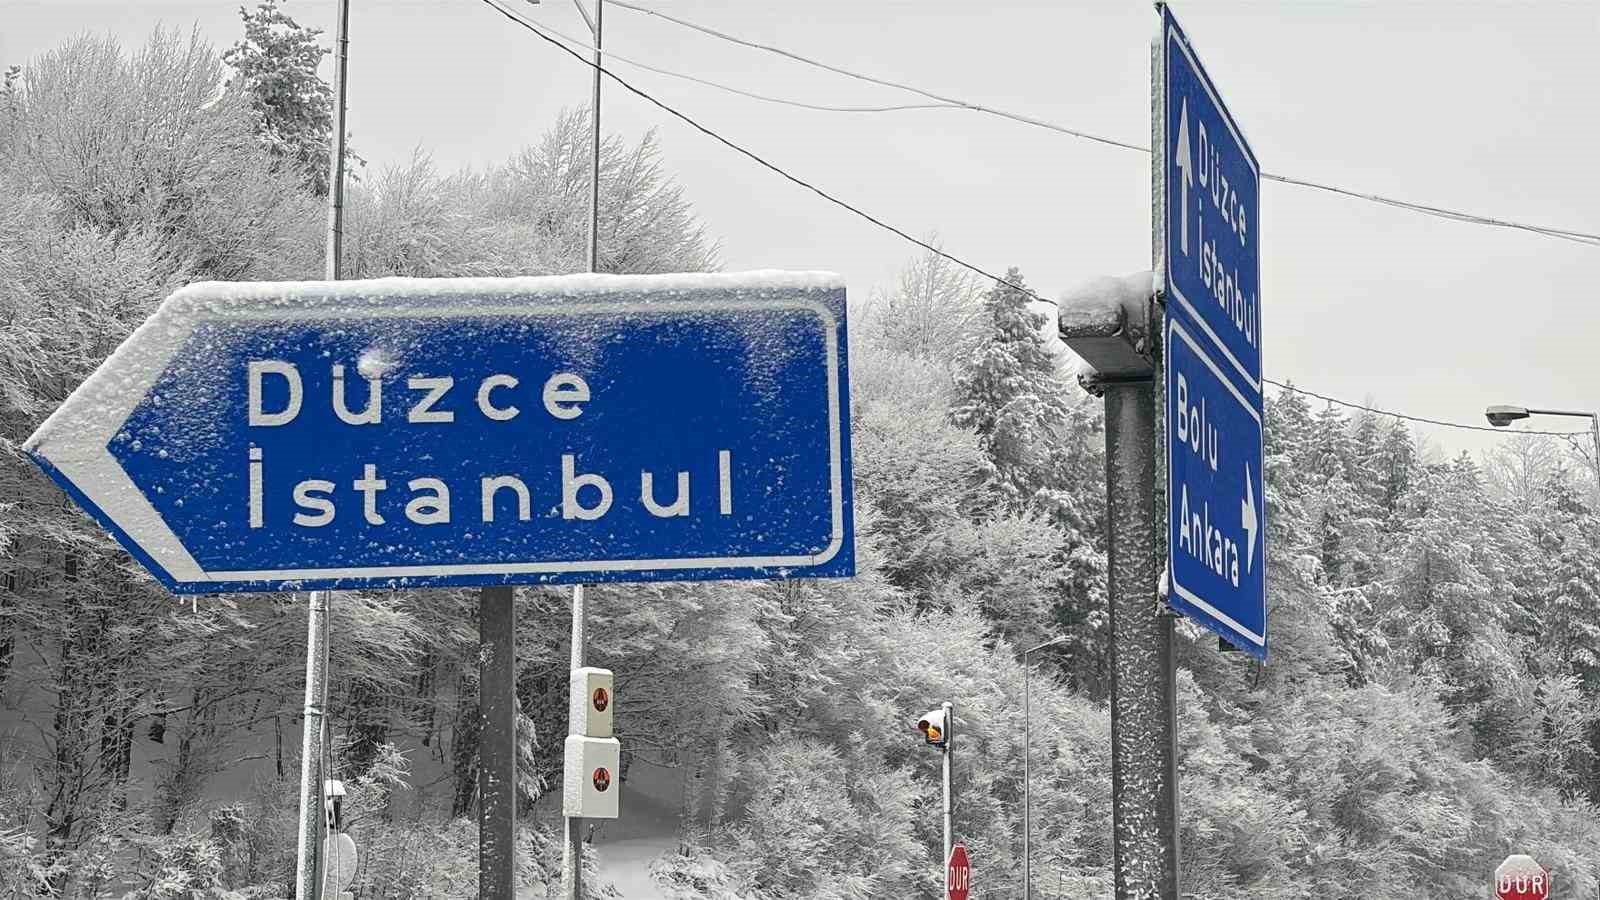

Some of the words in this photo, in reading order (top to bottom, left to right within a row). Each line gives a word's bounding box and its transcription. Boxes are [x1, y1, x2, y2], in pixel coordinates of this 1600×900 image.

[1198, 121, 1247, 246] Düzce
[1198, 202, 1256, 348] İstanbul
[248, 358, 592, 427] Düzce
[1177, 371, 1218, 471] Bolu
[248, 446, 733, 528] İstanbul
[1179, 483, 1239, 587] Ankara
[949, 866, 967, 890] DUR
[1500, 875, 1543, 894] DUR
